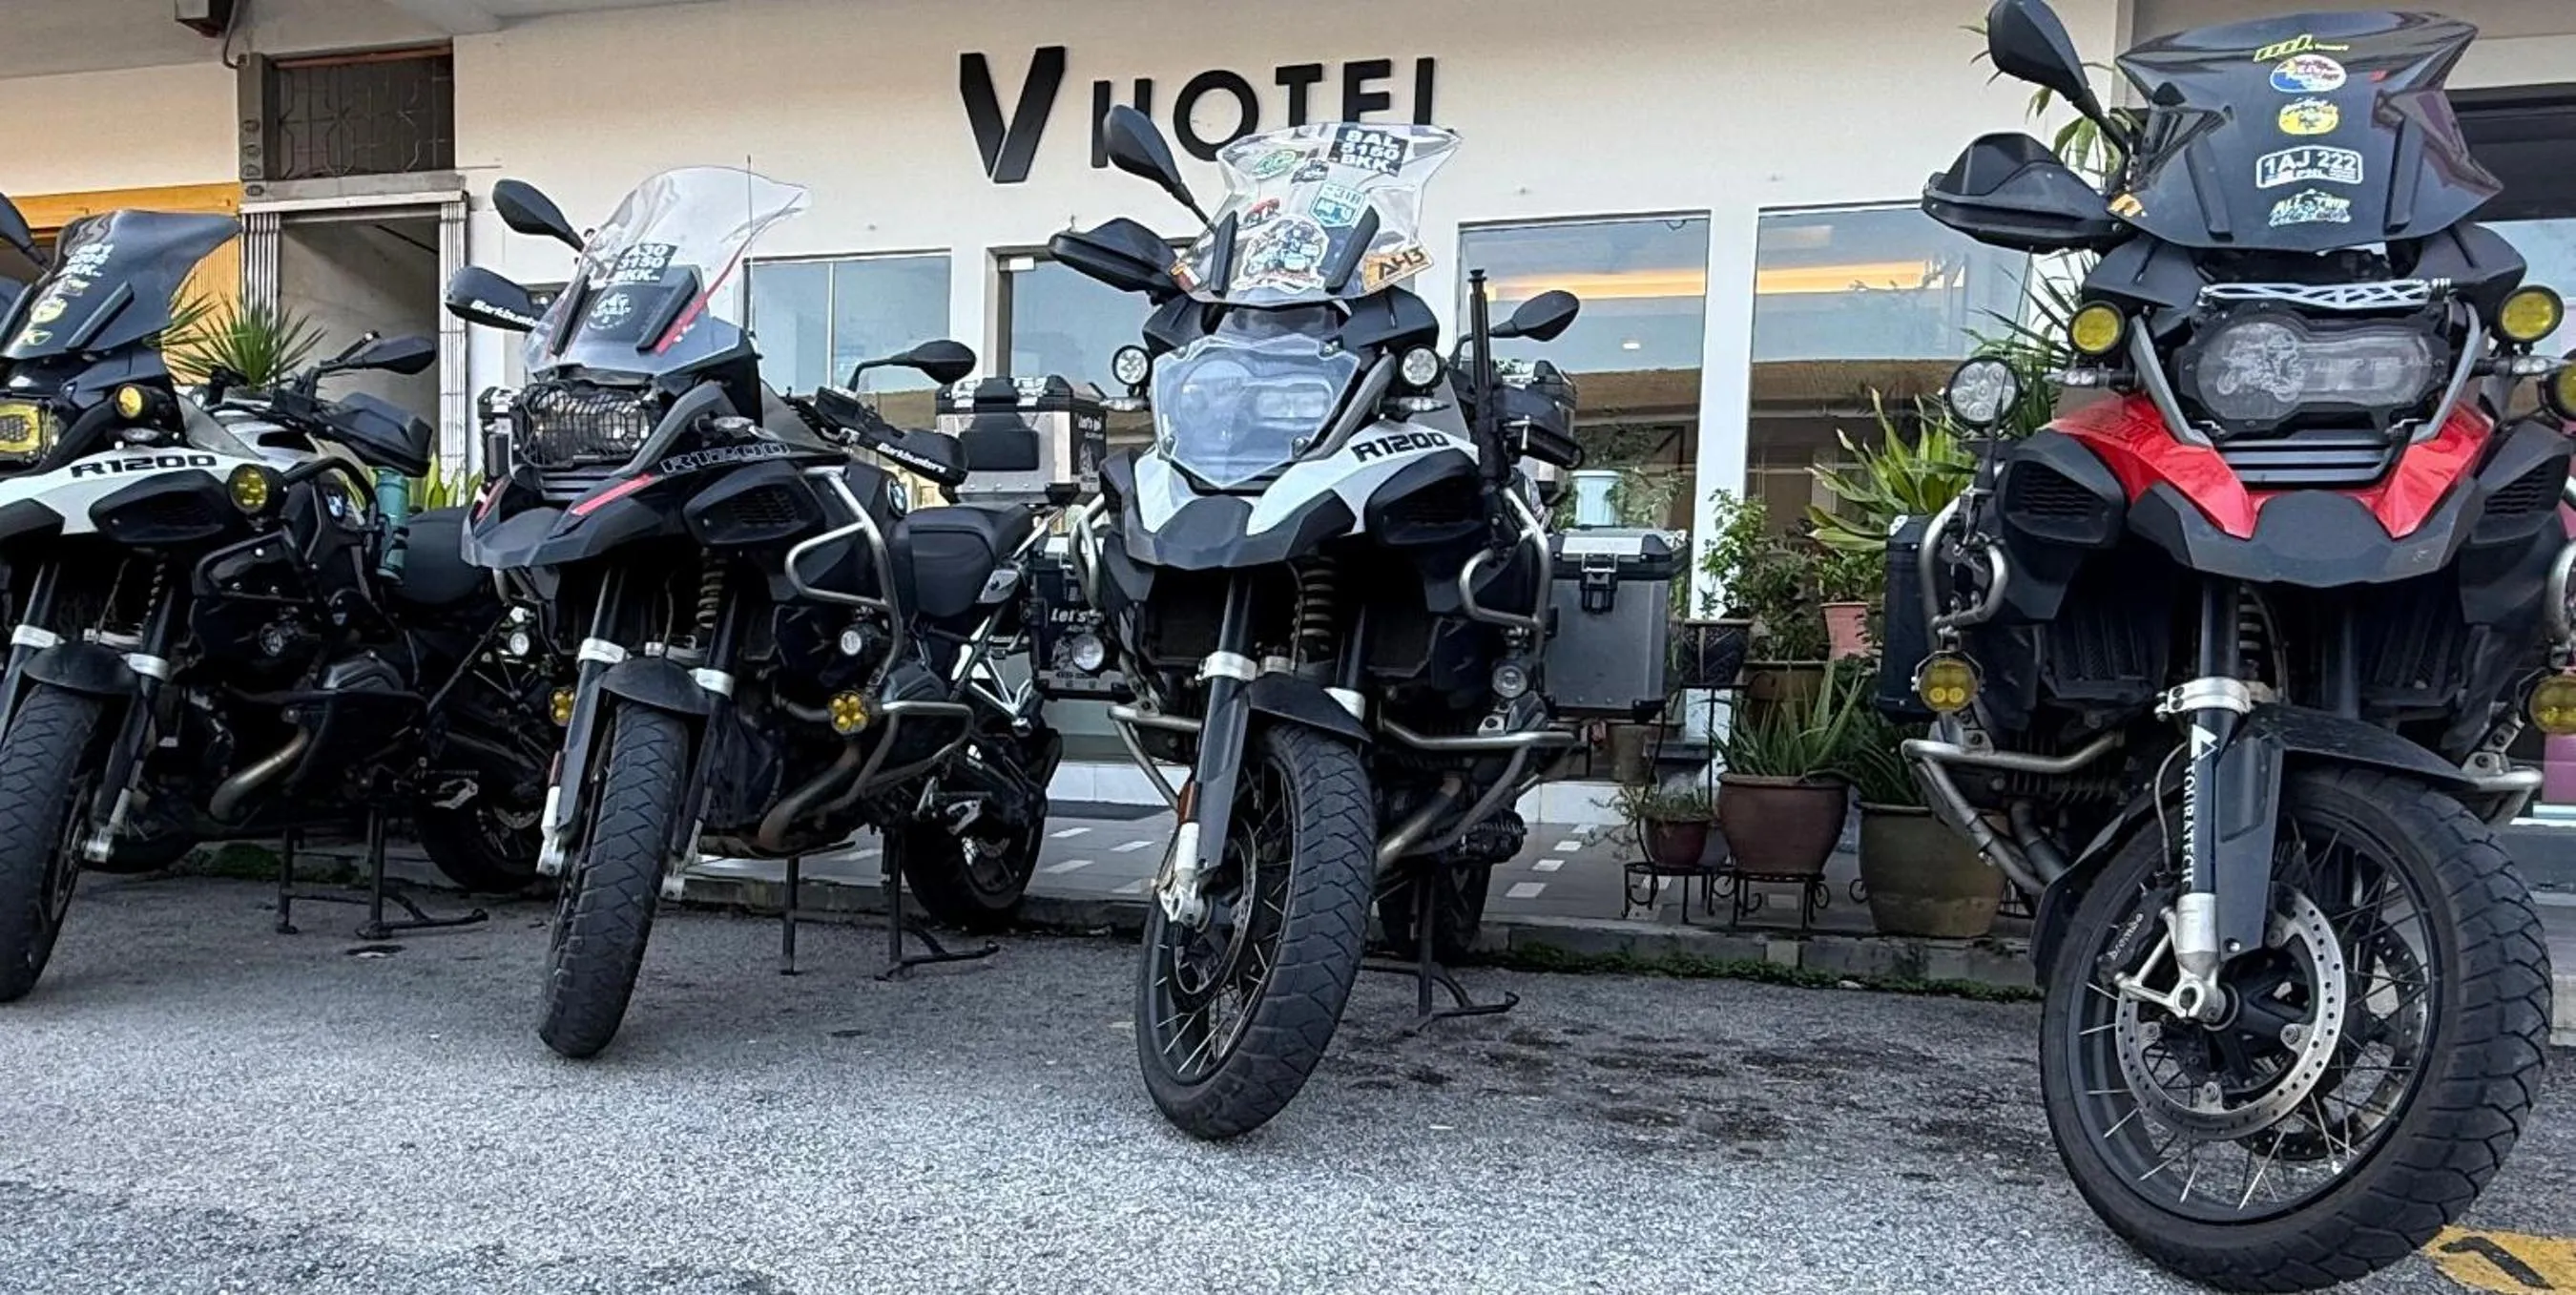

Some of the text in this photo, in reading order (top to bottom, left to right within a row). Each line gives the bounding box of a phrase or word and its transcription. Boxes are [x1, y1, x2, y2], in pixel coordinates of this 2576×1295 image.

[960, 46, 1066, 183] V
[2264, 151, 2310, 175] 1AJ
[2316, 151, 2357, 170] 222
[1350, 432, 1450, 463] R1200
[70, 454, 218, 478] R1200
